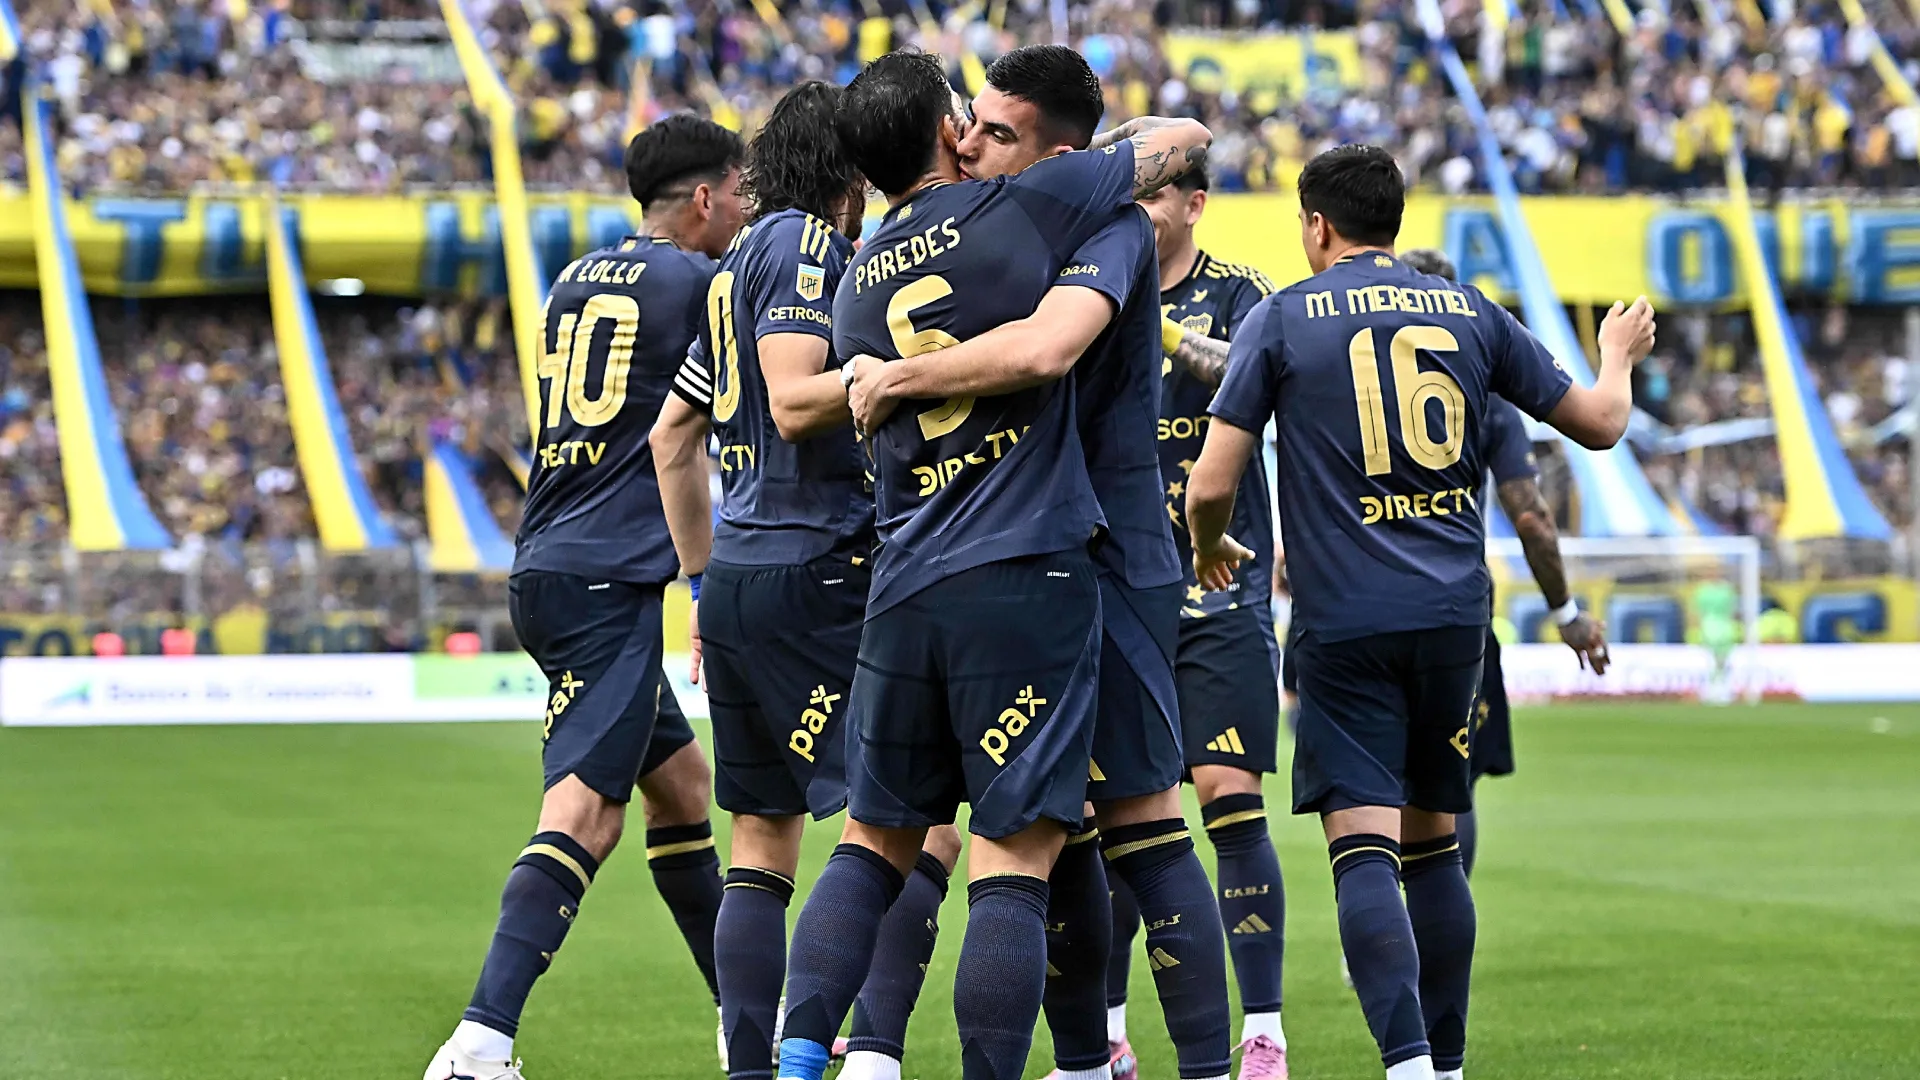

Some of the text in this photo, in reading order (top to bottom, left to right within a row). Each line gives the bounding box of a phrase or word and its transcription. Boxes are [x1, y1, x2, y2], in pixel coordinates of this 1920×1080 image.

[577, 260, 647, 285] LOLLO
[855, 216, 961, 295] PAREDES
[1305, 285, 1477, 318] M. MERENTIEL
[537, 294, 639, 428] 40
[1349, 325, 1465, 477] 16
[788, 684, 841, 764] pax
[979, 684, 1047, 766] pax
